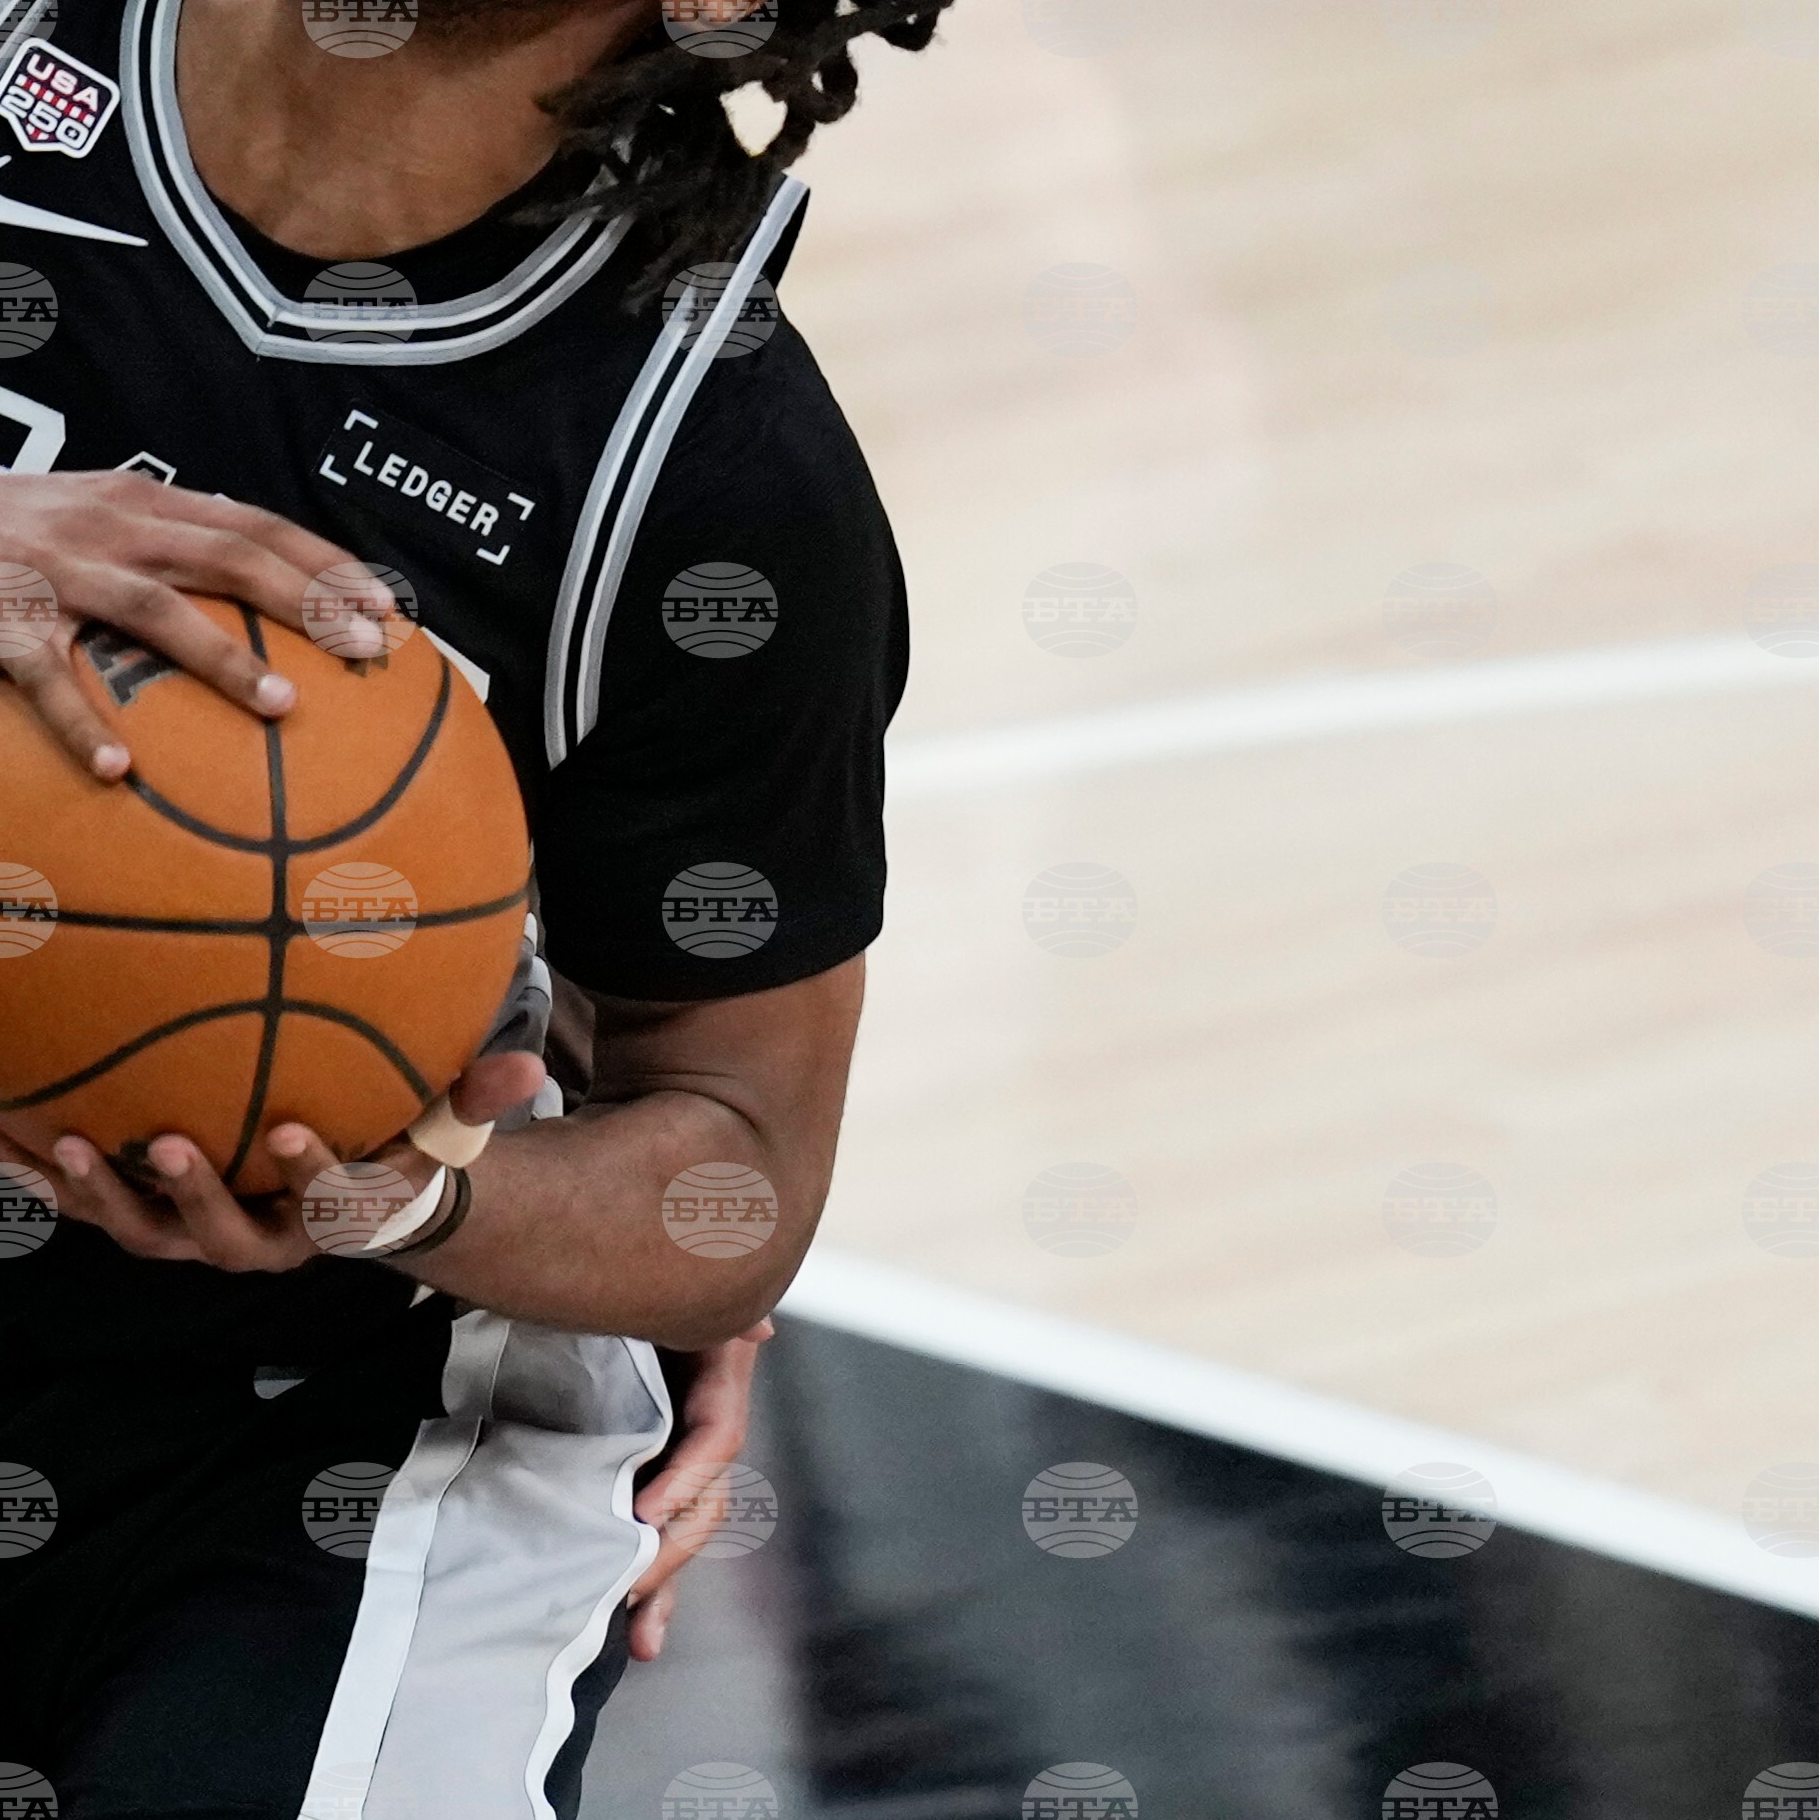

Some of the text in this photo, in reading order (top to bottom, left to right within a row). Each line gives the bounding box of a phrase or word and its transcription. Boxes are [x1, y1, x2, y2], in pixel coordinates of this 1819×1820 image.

[26, 53, 99, 113] USA
[0, 85, 90, 149] 250
[353, 440, 500, 537] LEDGER
